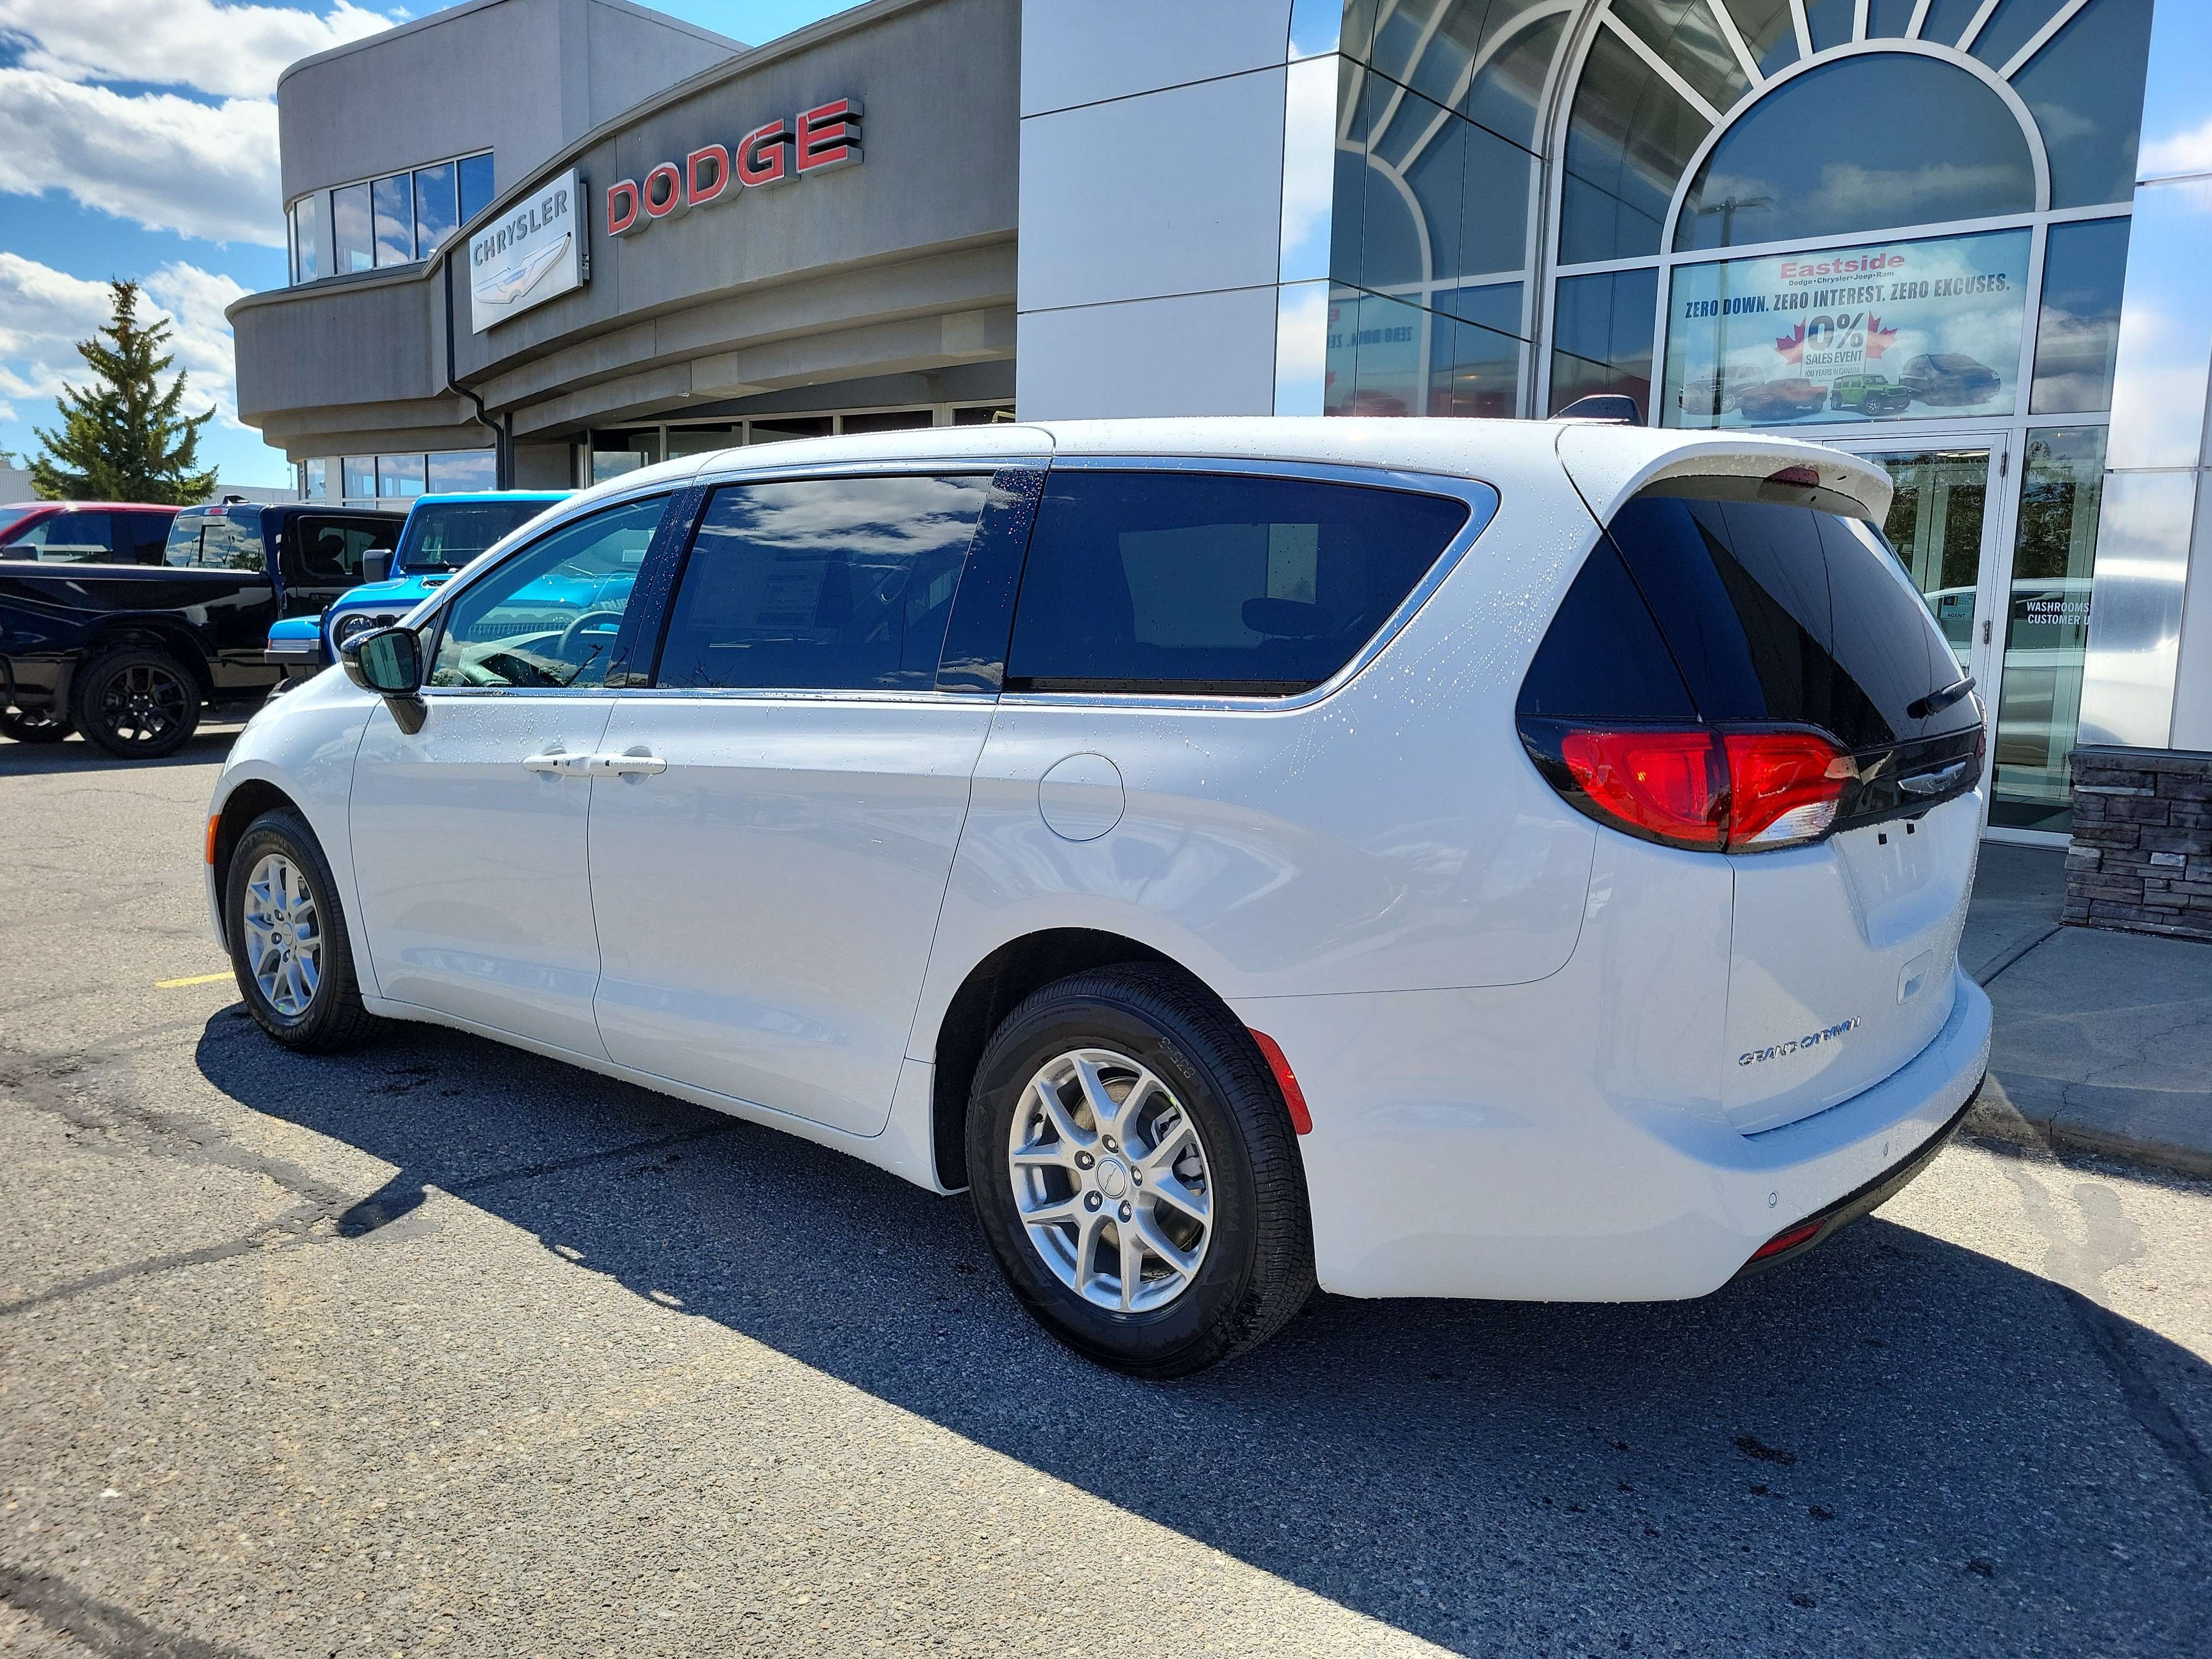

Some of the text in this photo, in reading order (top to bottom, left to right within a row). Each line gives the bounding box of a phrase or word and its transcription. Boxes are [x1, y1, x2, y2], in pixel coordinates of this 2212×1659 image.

[607, 97, 862, 238] DODGE
[473, 190, 568, 267] CHRYSLER
[1781, 253, 1905, 279] Eastside
[1817, 275, 1849, 284] Chrysler
[1685, 273, 2010, 318] ZERO DOWN. ZERO INTEREST. ZERO EXCUSES.
[1808, 312, 1864, 351] 0%
[1806, 350, 1863, 365] SALES EVENT
[1839, 367, 1860, 375] CANADA
[2027, 601, 2089, 612] WASHROOMS
[2027, 614, 2080, 625] CUSTOMER
[1739, 1015, 1861, 1066] GRAND CARAVAN
